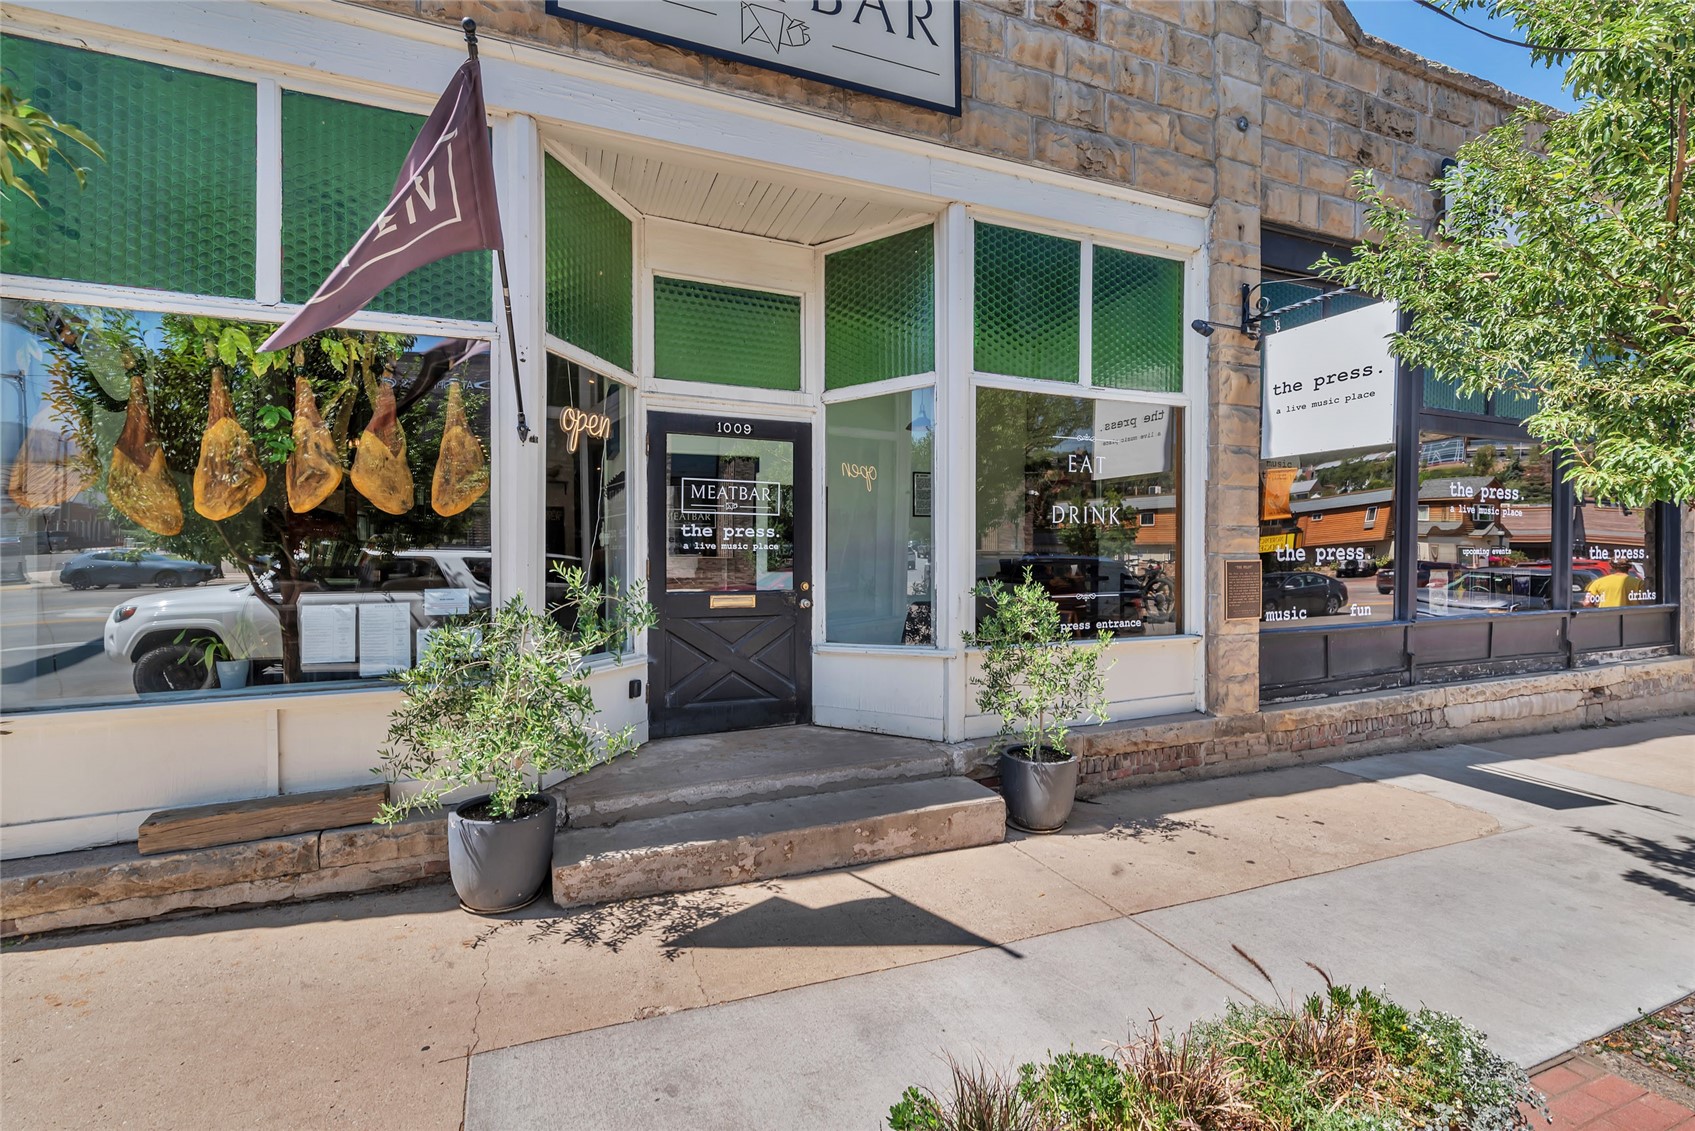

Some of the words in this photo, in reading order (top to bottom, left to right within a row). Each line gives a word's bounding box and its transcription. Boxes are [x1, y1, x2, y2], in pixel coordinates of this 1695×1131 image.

[1273, 382, 1303, 396] the
[1313, 365, 1383, 391] press.
[1286, 403, 1307, 413] live
[1311, 396, 1340, 408] music
[1345, 390, 1376, 403] place
[561, 407, 611, 453] open
[717, 422, 752, 435] 1009
[1068, 454, 1106, 474] EAT
[691, 484, 771, 501] MEATBAR
[1449, 482, 1473, 497] the
[1480, 486, 1525, 503] press.
[1052, 505, 1121, 525] DRINK
[1449, 505, 1455, 513] a
[1458, 504, 1476, 514] live
[1478, 506, 1500, 515] music
[1502, 507, 1523, 517] place
[681, 523, 713, 537] the
[723, 526, 780, 541] press.
[694, 542, 717, 550] live
[753, 543, 779, 551] place
[1276, 544, 1306, 562] the
[1315, 546, 1372, 565] press.
[1462, 548, 1490, 557] upcoming
[1589, 546, 1609, 560] the
[1614, 548, 1649, 563] press.
[1585, 592, 1606, 603] food
[1628, 589, 1656, 601] drinks
[1265, 606, 1307, 622] music
[1350, 604, 1371, 617] fun
[1060, 621, 1091, 633] press
[1096, 619, 1142, 629] entrance
